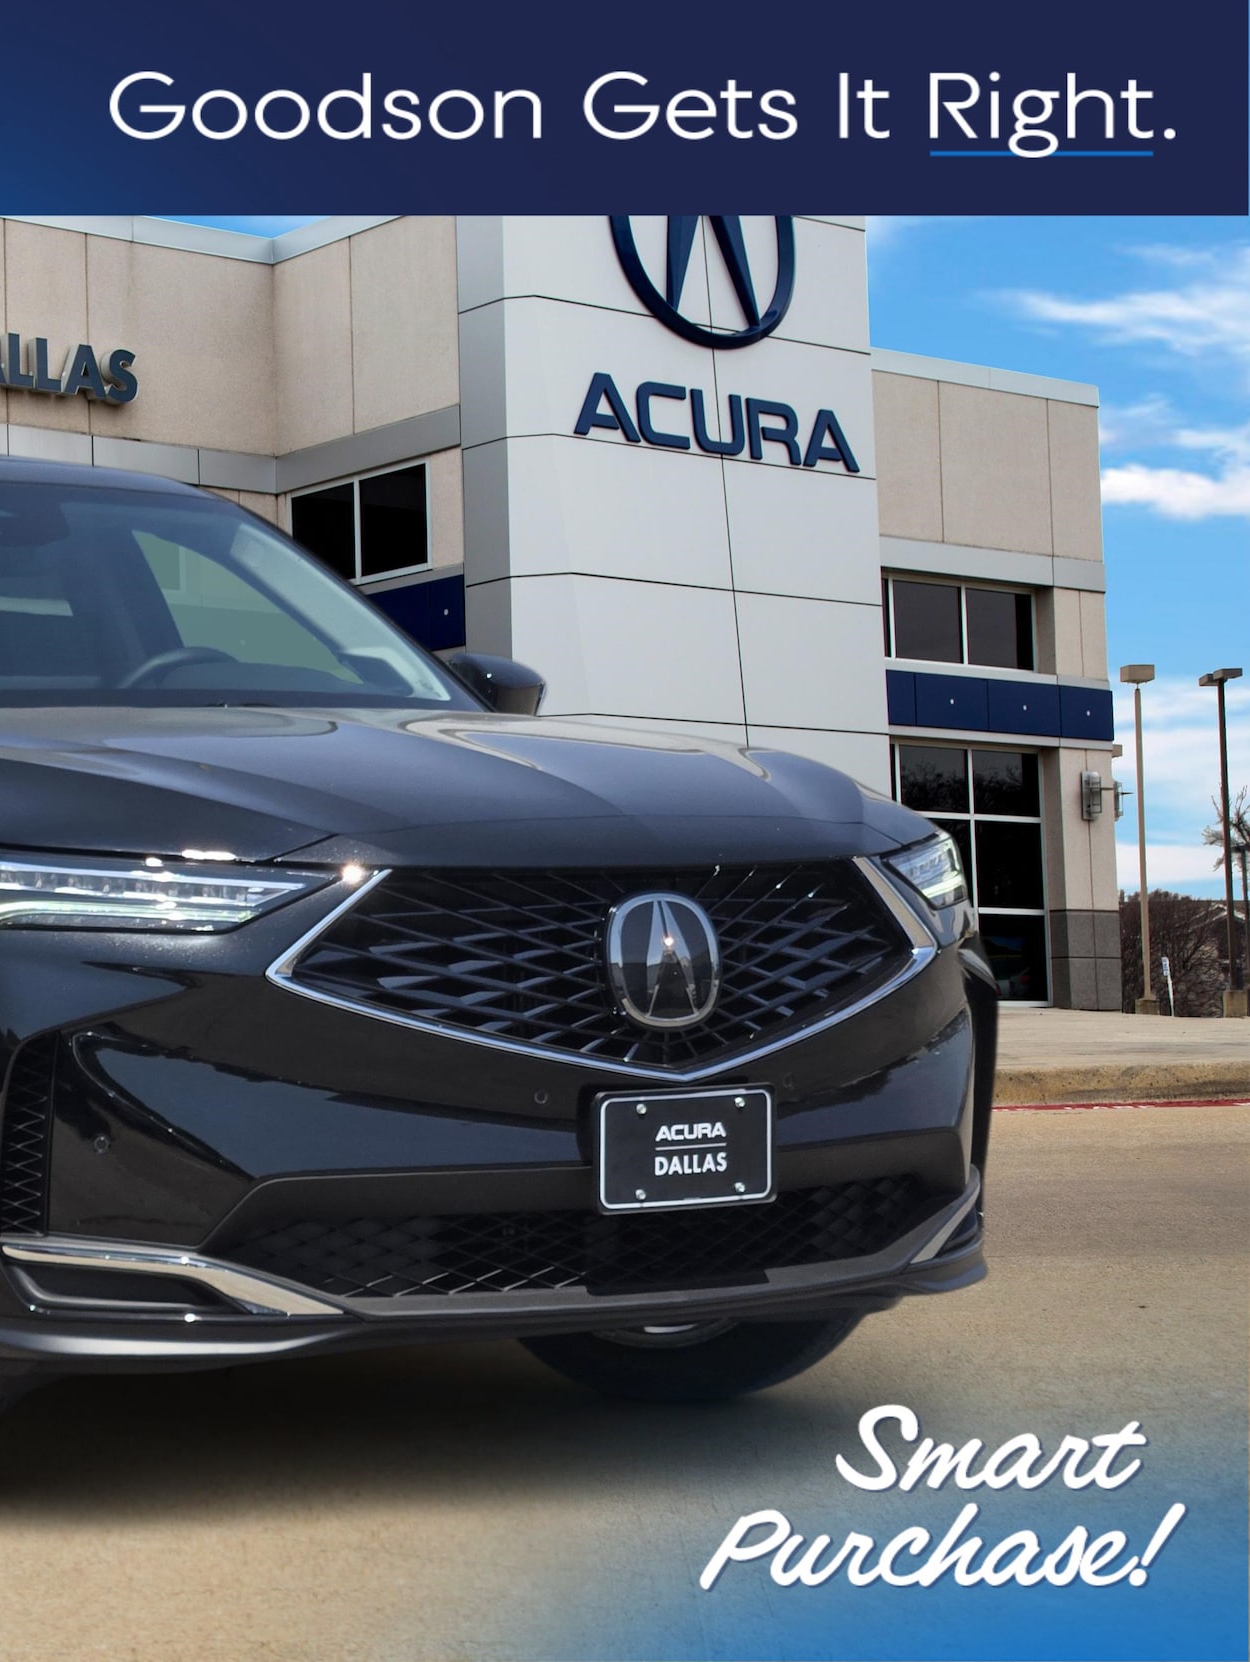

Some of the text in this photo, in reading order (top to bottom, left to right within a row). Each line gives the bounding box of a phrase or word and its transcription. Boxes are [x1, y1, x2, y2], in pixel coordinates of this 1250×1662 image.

[574, 372, 860, 473] ACURA
[655, 1121, 727, 1142] ACURA
[654, 1151, 728, 1176] DALLAS
